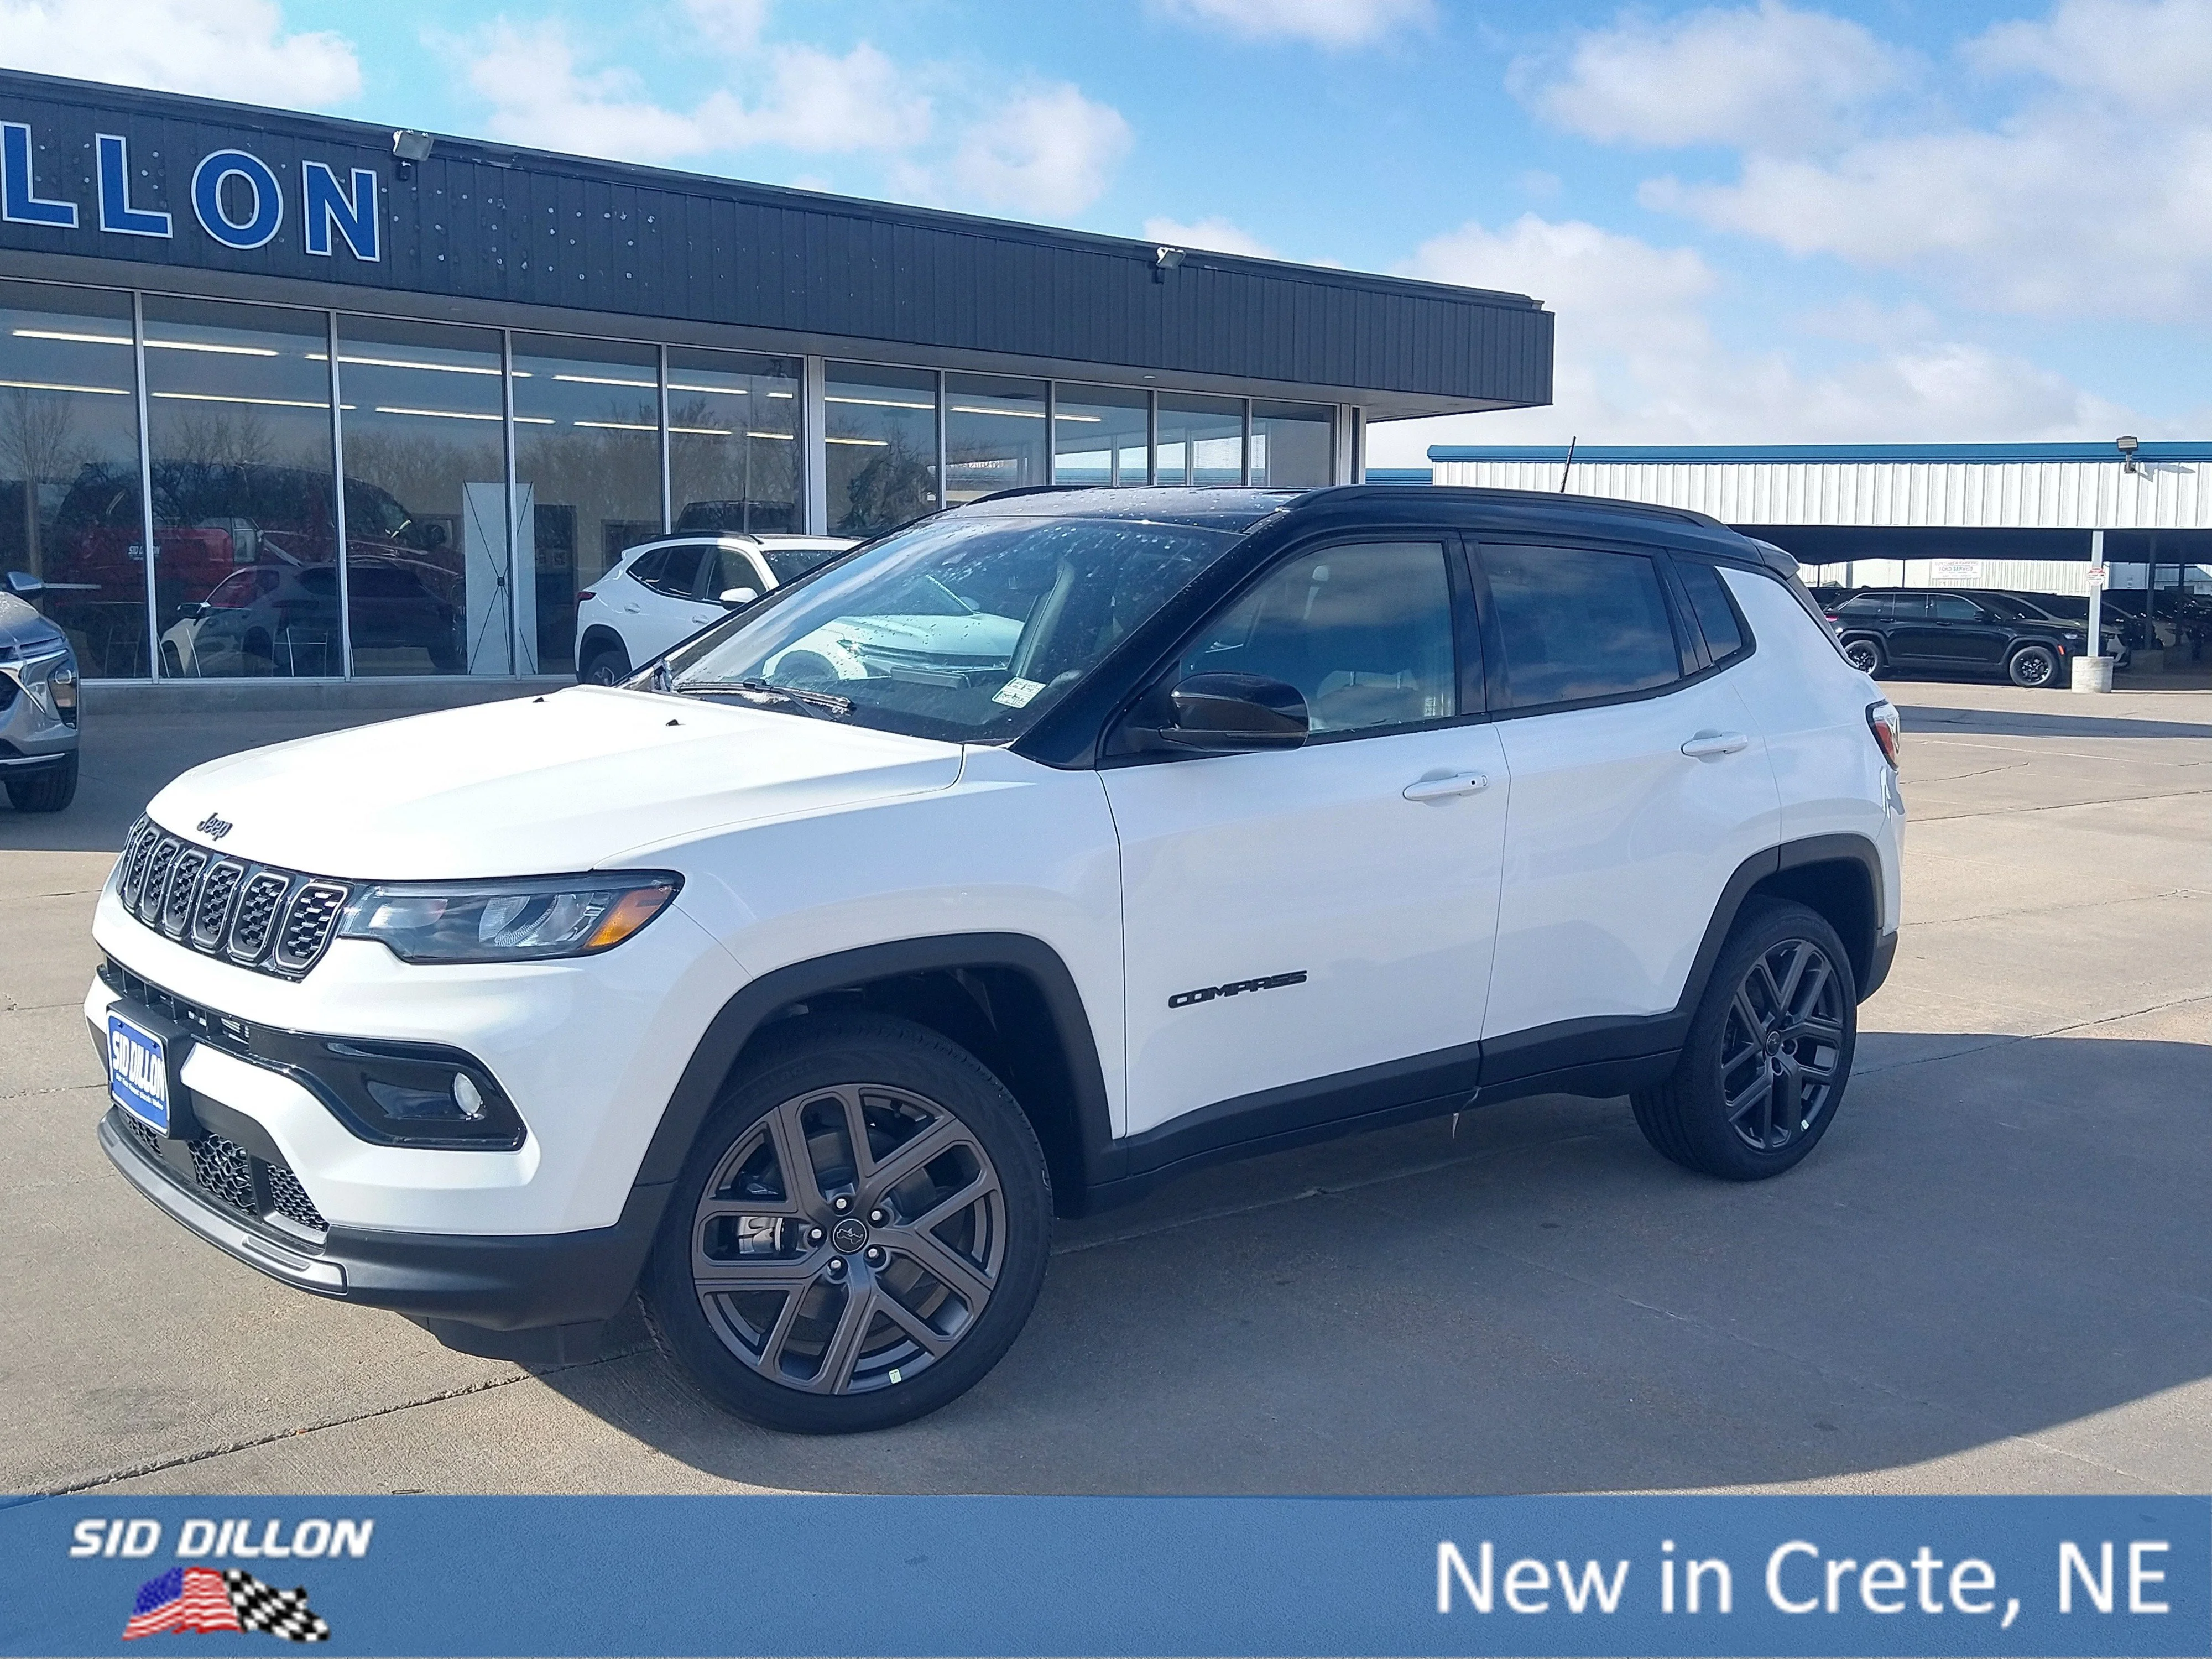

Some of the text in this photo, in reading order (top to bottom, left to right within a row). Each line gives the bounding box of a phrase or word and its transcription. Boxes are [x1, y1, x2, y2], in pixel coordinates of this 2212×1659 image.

[0, 120, 380, 262] LLON
[197, 812, 233, 841] Jeep
[1168, 970, 1307, 1009] COMPASS
[112, 1031, 130, 1077] SID
[129, 1041, 165, 1102] DILLON
